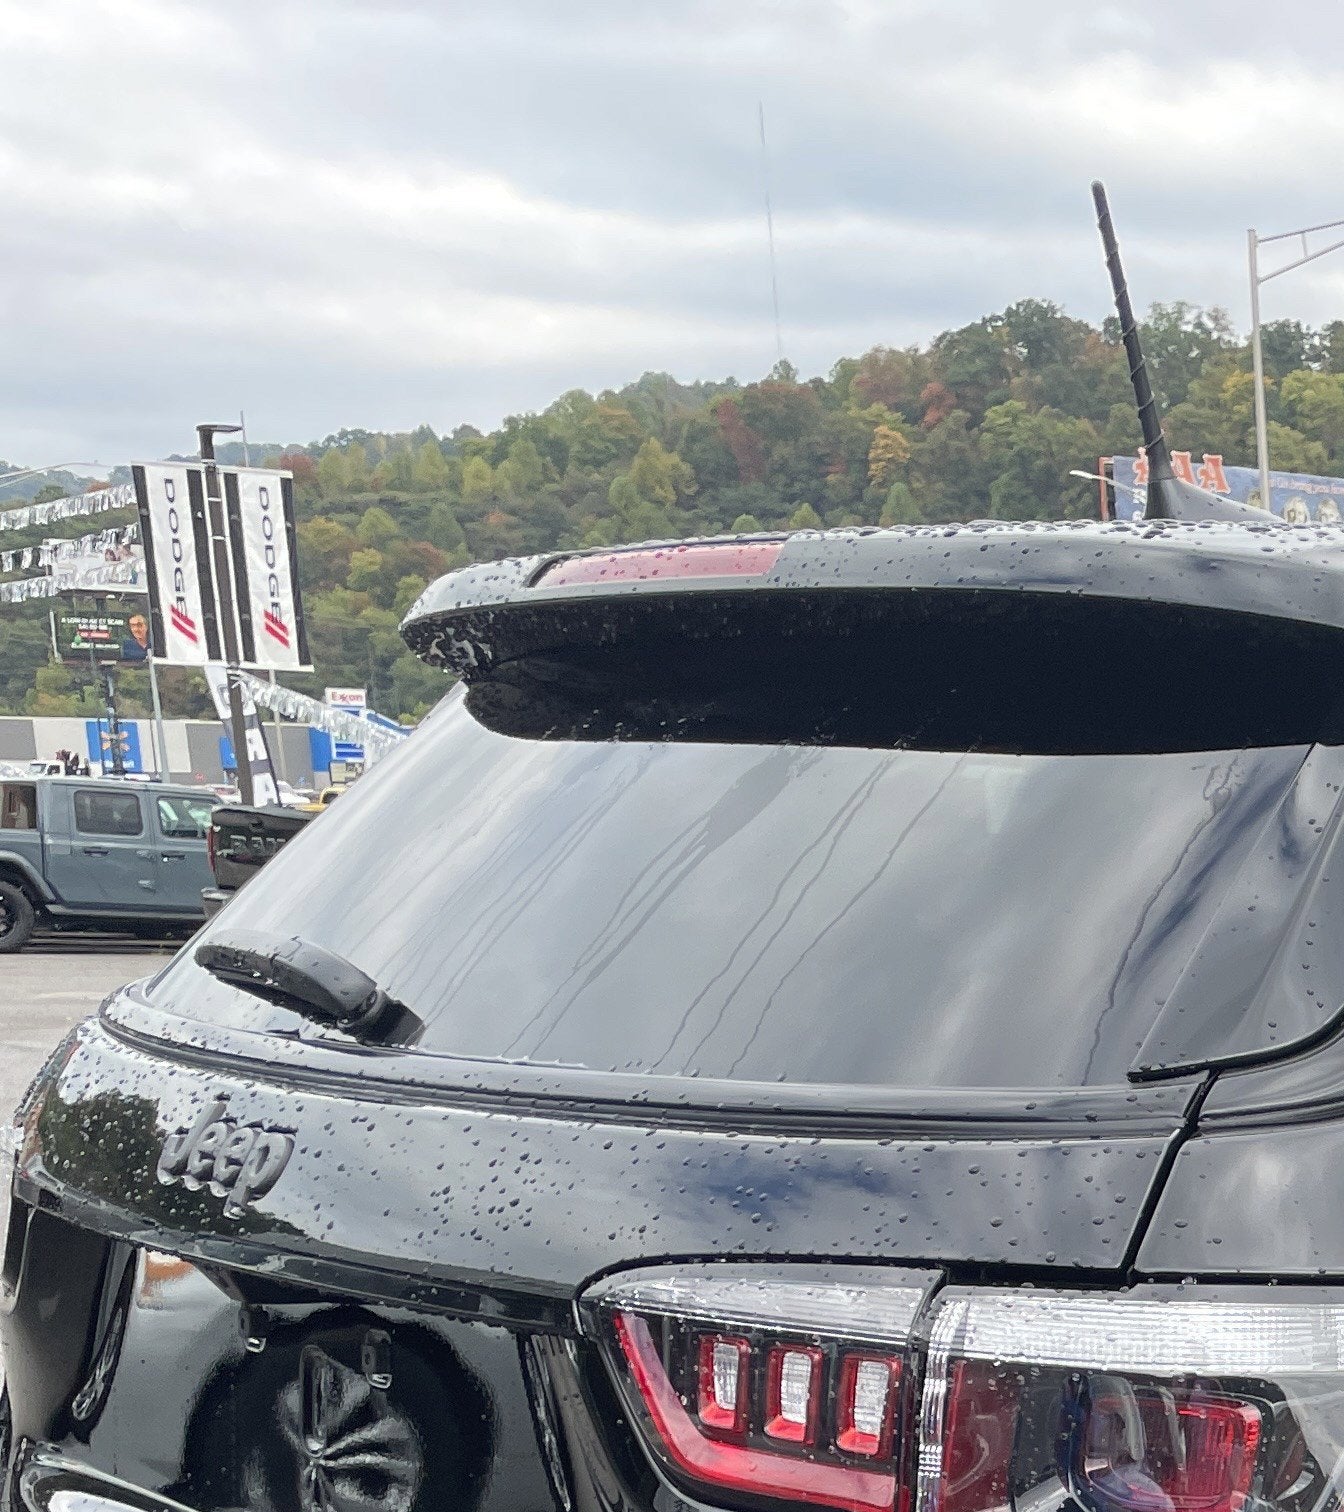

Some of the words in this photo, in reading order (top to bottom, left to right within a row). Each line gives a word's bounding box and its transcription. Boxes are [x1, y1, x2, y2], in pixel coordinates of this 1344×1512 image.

[164, 478, 188, 618] DODGE
[259, 487, 282, 625] DODGE
[157, 1097, 296, 1220] Jeep
